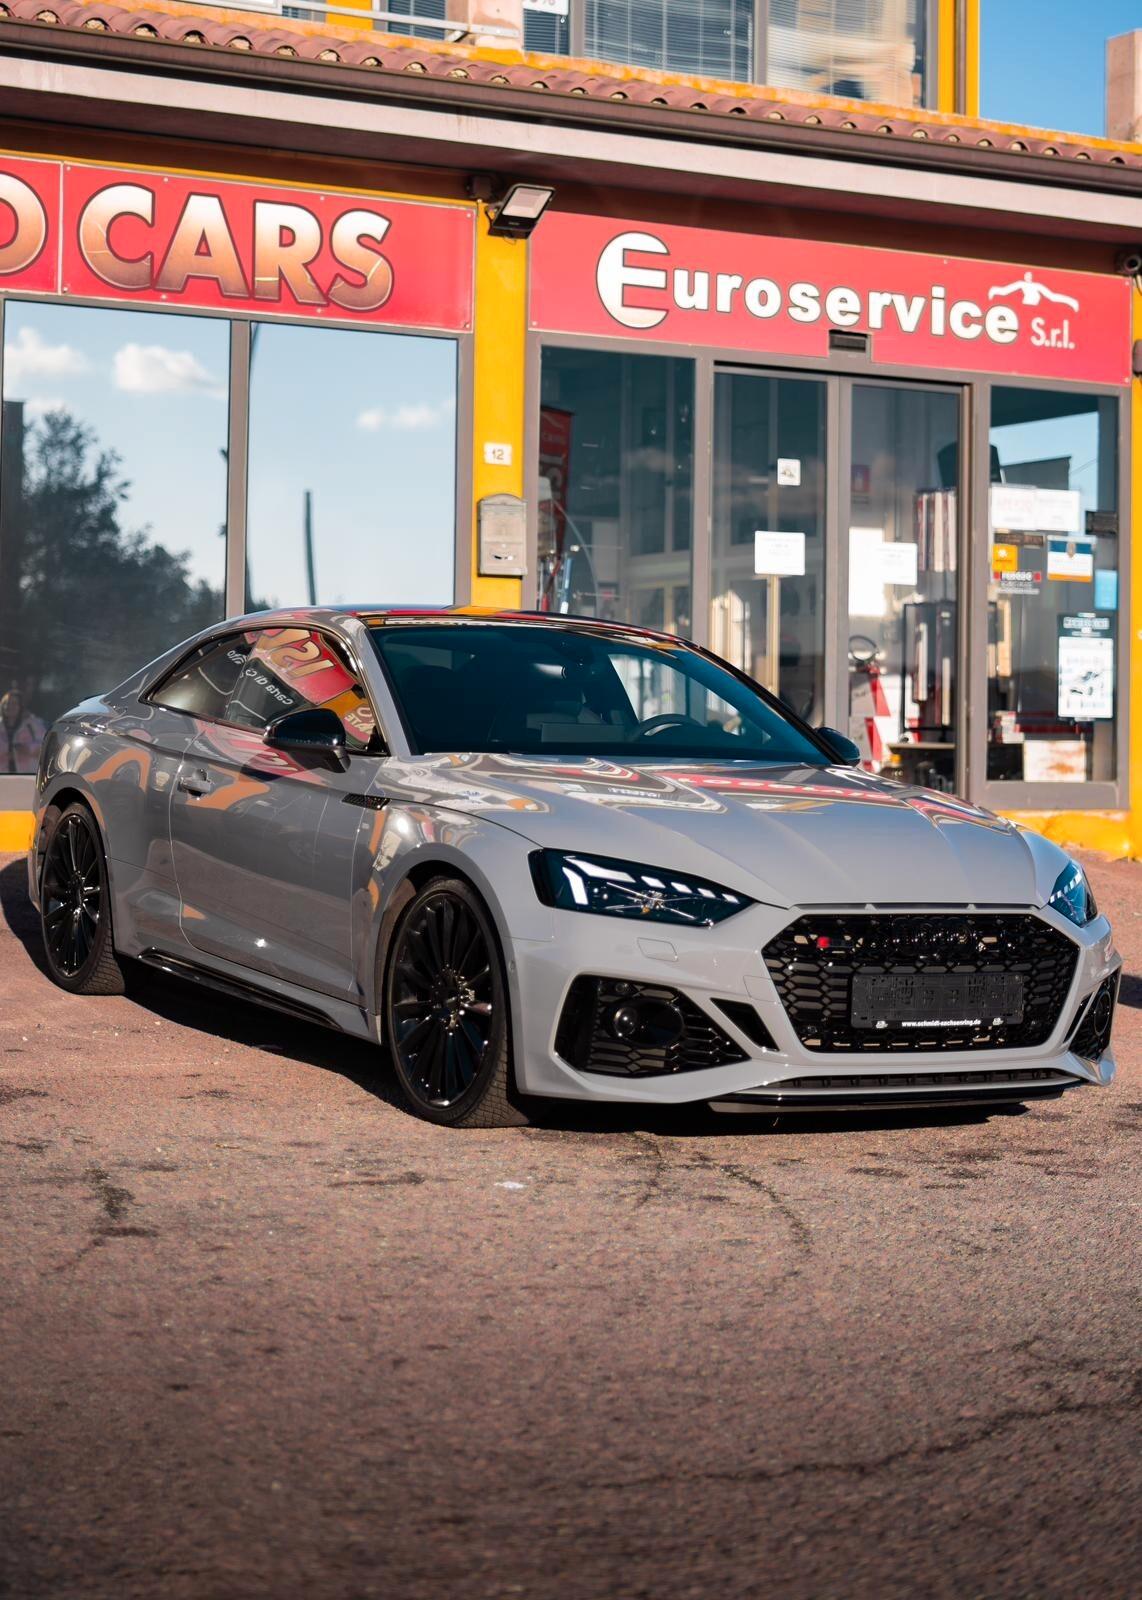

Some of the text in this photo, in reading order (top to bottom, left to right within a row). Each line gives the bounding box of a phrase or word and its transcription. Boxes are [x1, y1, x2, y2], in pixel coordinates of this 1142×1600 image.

[77, 182, 394, 312] CARS
[596, 231, 1076, 350] Euroservice S.r.l.
[492, 448, 504, 460] 12
